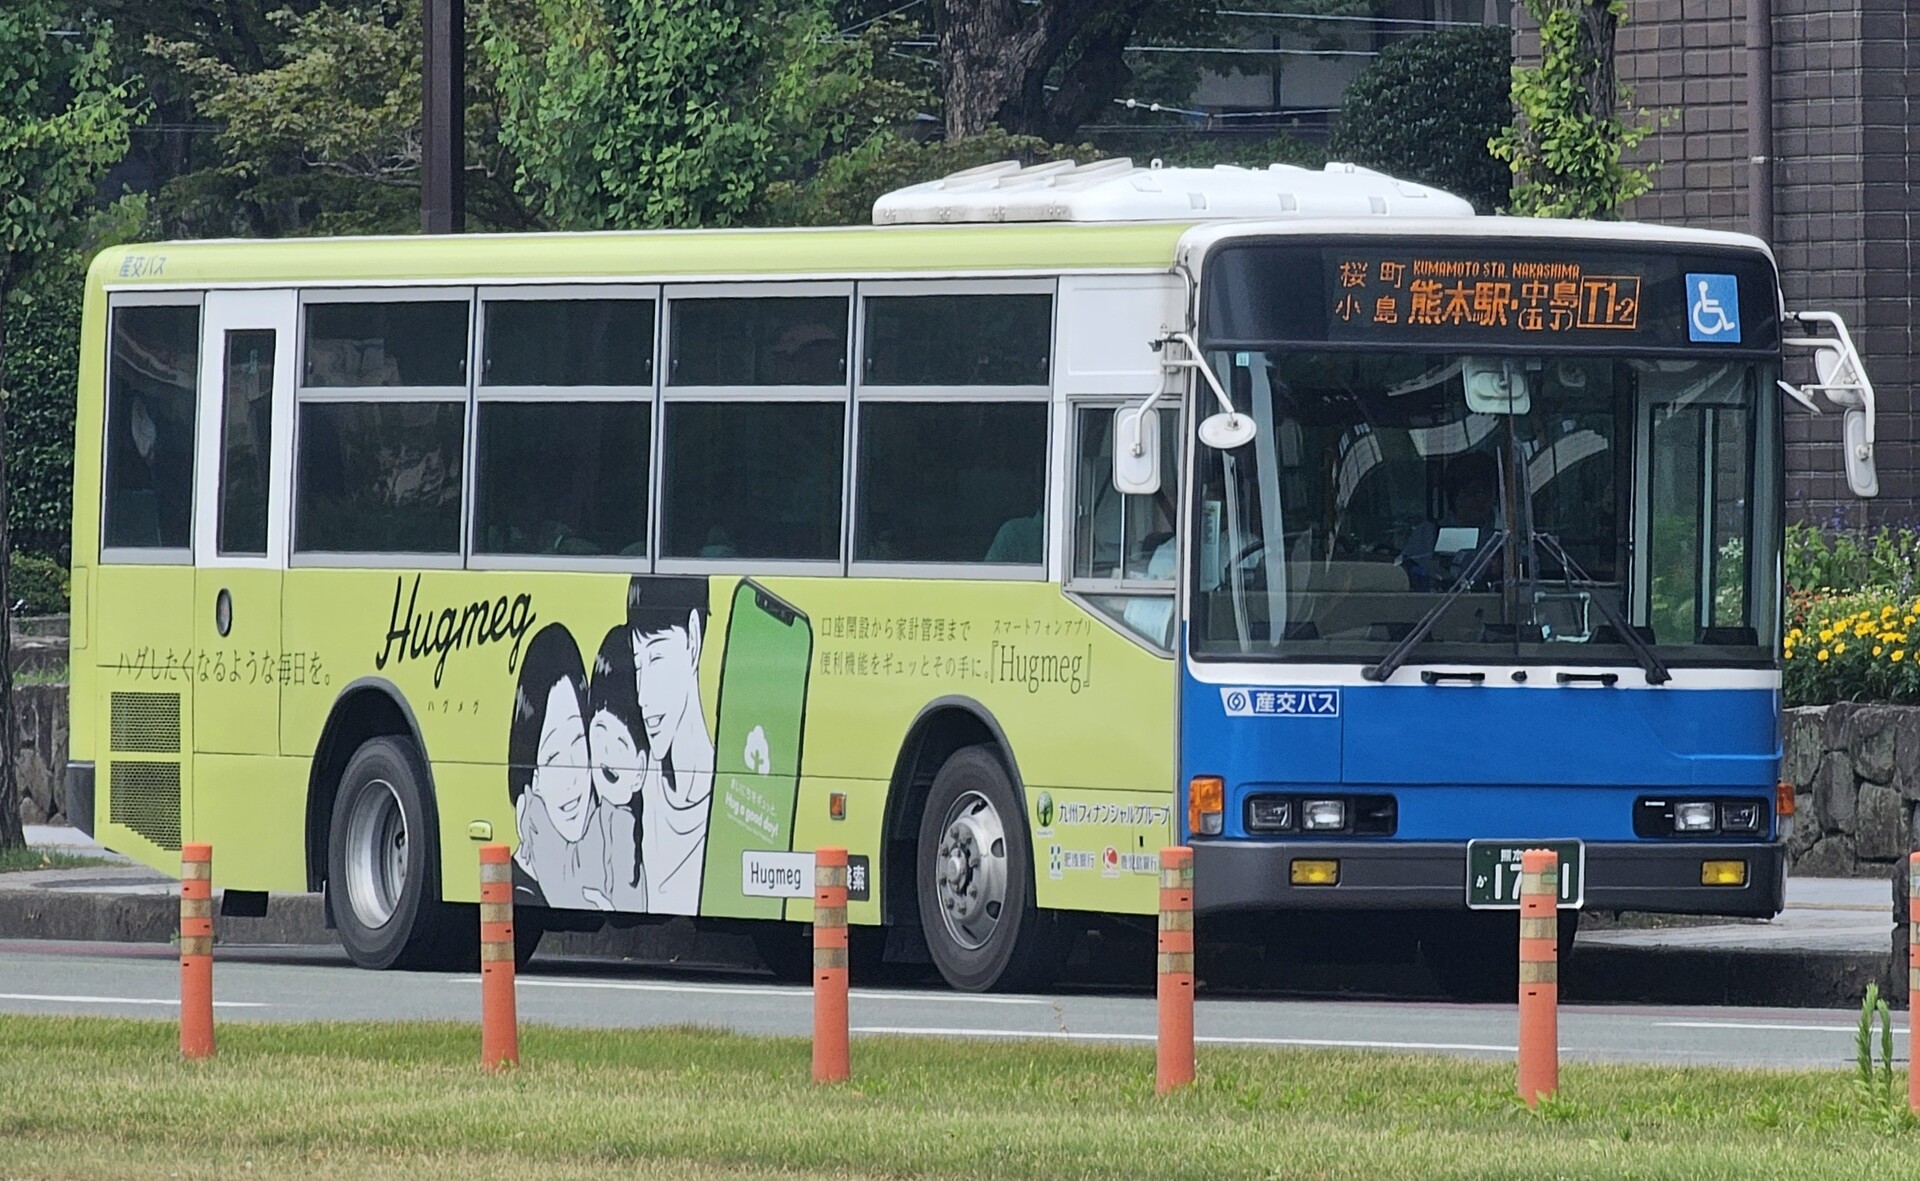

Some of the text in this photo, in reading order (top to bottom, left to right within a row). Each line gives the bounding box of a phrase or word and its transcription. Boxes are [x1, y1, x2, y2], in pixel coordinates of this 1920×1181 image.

[119, 255, 167, 278] 産交バス
[1339, 262, 1406, 289] 桜町
[1413, 260, 1580, 280] KUMAMOTO STA. NAKASHIMA
[1335, 294, 1398, 324] 小島
[375, 572, 537, 690] Hugmeg
[821, 614, 971, 642] 口座開設から家計管理まで
[993, 617, 1092, 636] スマートフォンアプリ
[117, 646, 331, 686] ハグしたくなるような毎日を。
[1255, 691, 1336, 714] 産交バス
[1058, 802, 1170, 826] 九州フィナンシャルグループ
[750, 861, 802, 890] Hugmeg
